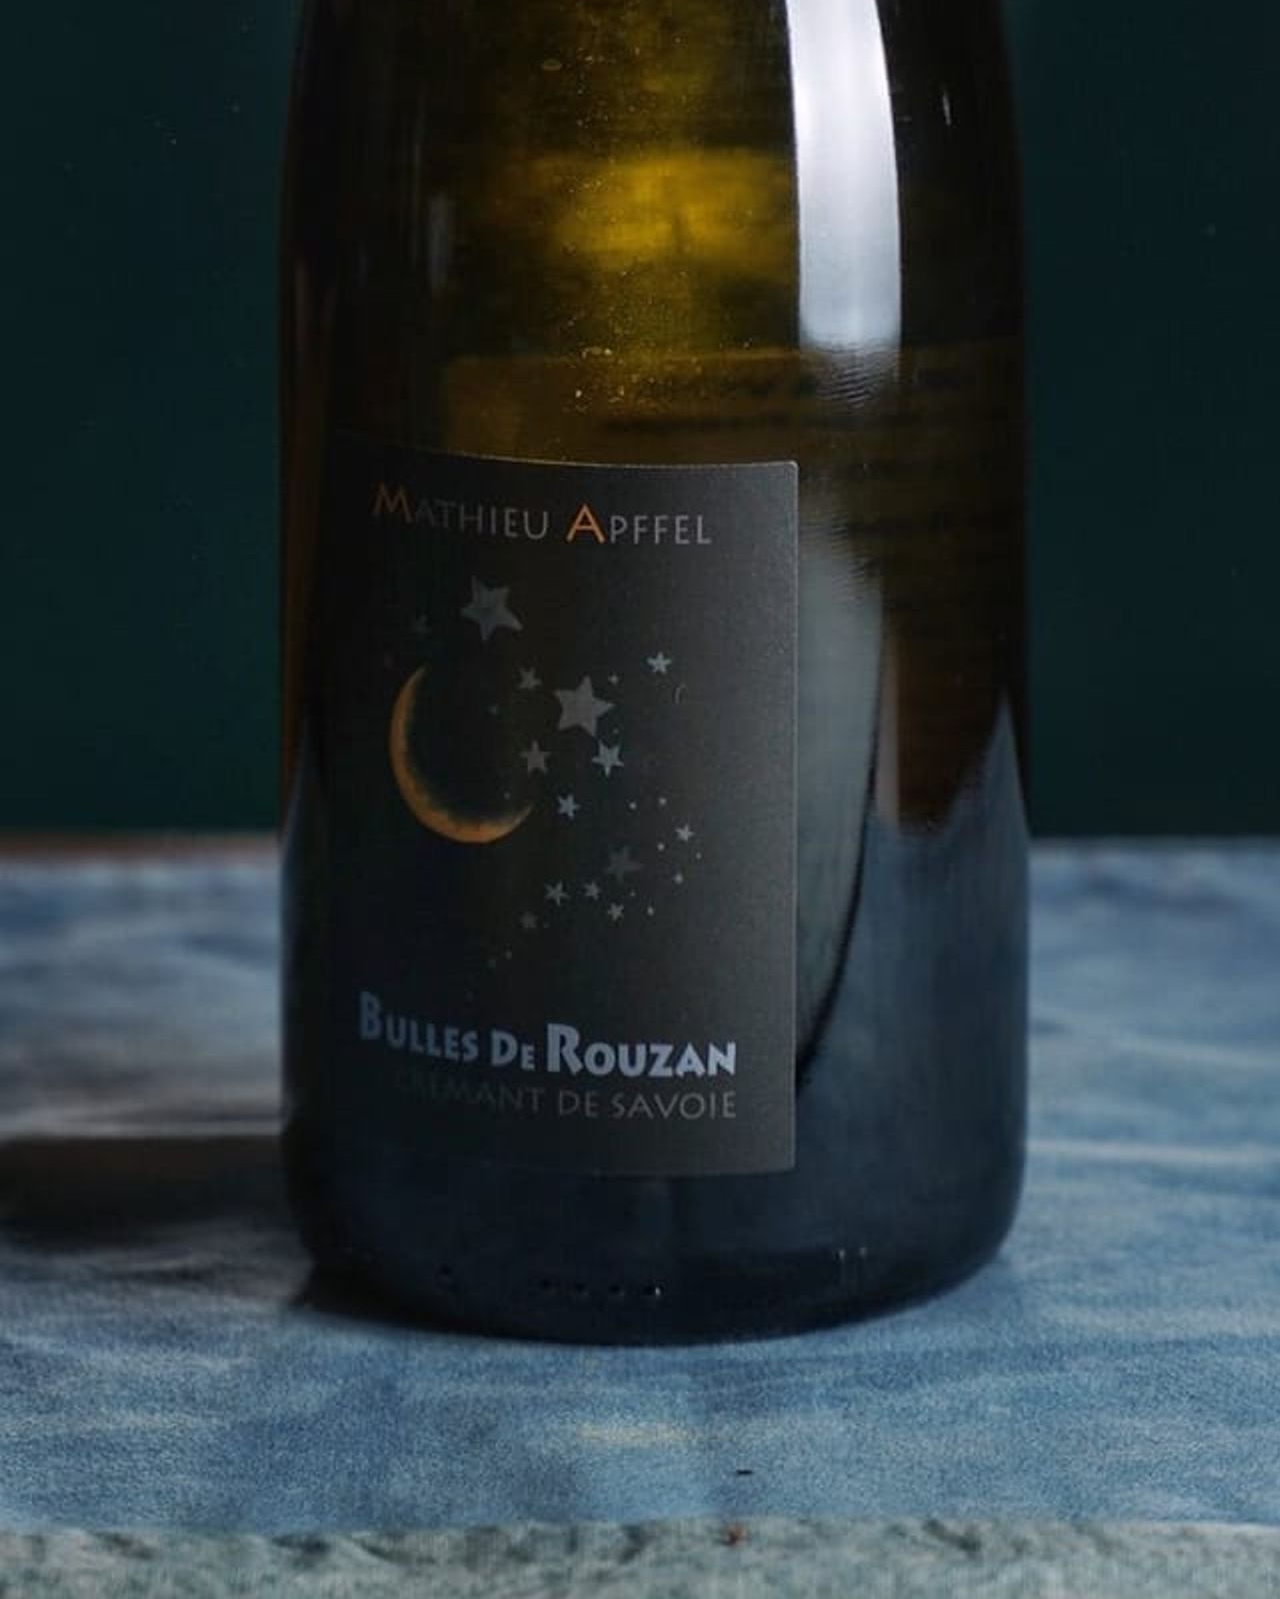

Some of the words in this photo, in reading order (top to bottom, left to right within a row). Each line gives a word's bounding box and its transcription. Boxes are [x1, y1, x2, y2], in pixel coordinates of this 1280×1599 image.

[371, 481, 550, 541] MATHIEU
[564, 502, 713, 546] APFFEL
[357, 989, 480, 1064] BULLES
[489, 1028, 538, 1072] DE
[545, 1022, 738, 1079] ROUZAN
[557, 1090, 602, 1119] DE
[609, 1090, 738, 1120] SAVOIE
